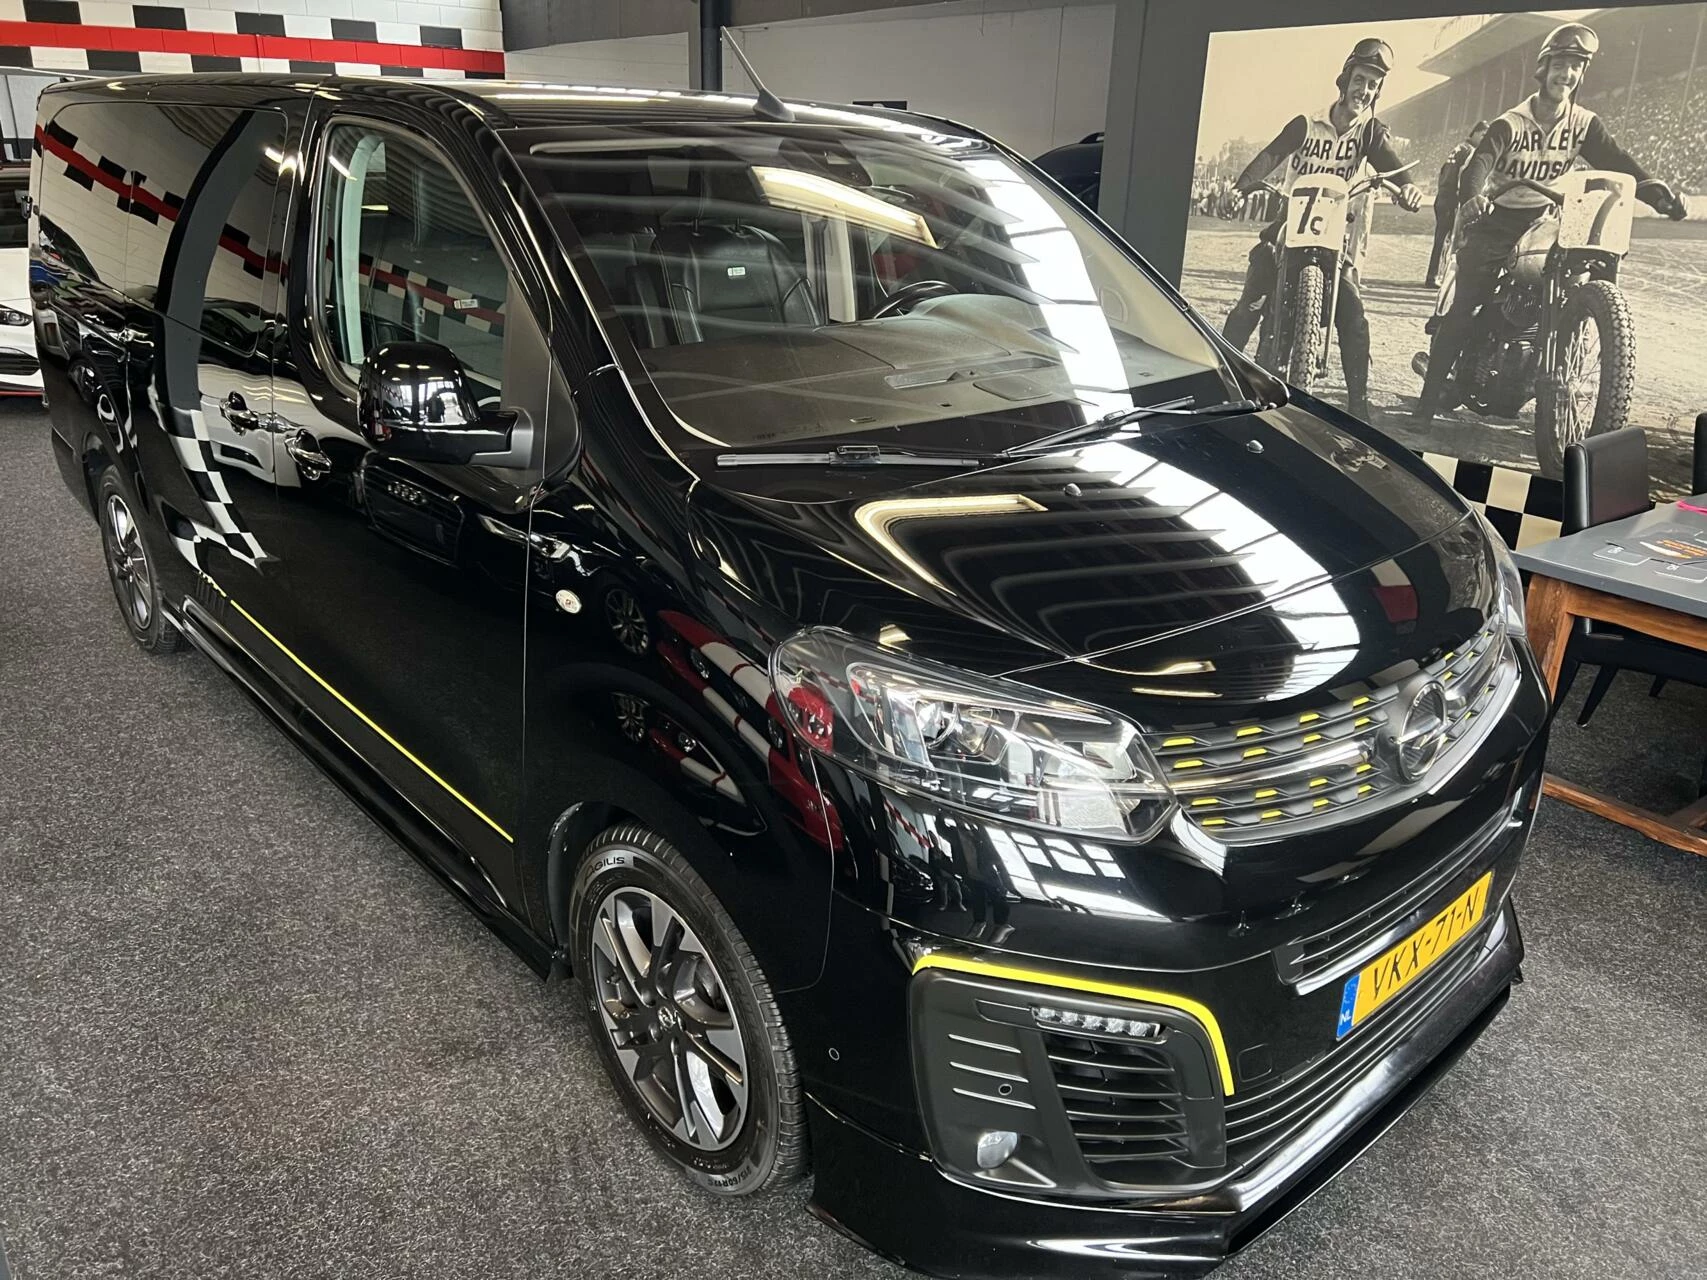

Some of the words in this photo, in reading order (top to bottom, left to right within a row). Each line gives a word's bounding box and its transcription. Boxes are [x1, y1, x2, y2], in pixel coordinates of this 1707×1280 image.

[1583, 178, 1623, 246] 7
[584, 856, 626, 887] AGILIS
[1373, 887, 1480, 1001] VKX-71-N
[1340, 1009, 1352, 1026] NL
